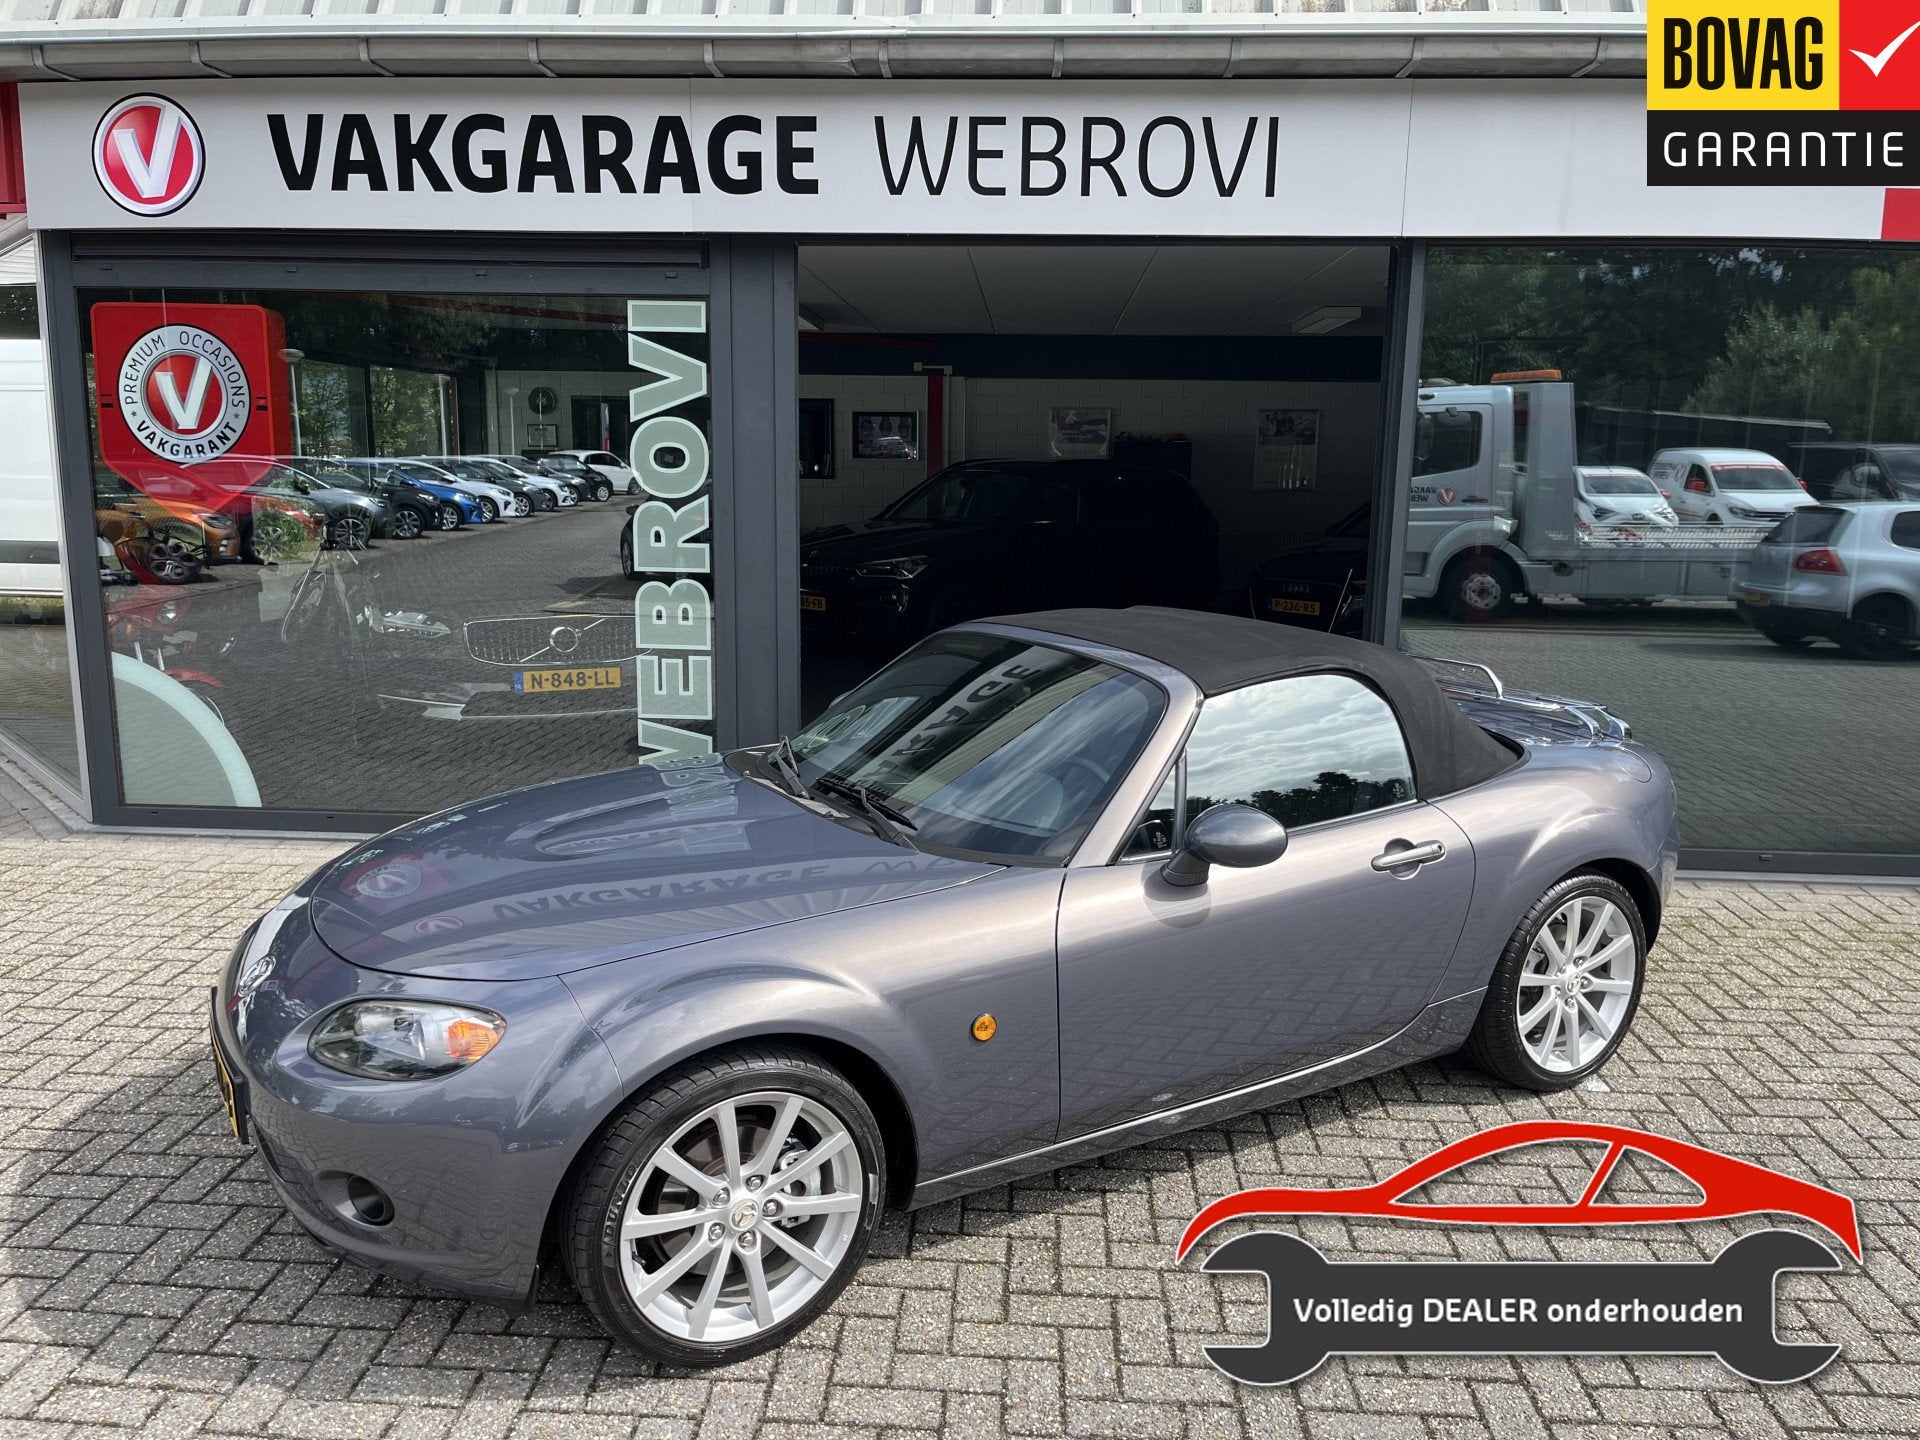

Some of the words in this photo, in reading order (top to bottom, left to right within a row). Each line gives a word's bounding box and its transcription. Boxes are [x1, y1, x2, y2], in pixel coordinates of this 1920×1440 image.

[267, 113, 819, 195] VAKGARAGE
[874, 115, 1279, 198] WEBROVI
[124, 334, 166, 405] PREMIUM
[179, 331, 246, 409] OCCASIONS
[136, 420, 238, 459] VAKGARANT
[531, 670, 615, 689] N-848-LL
